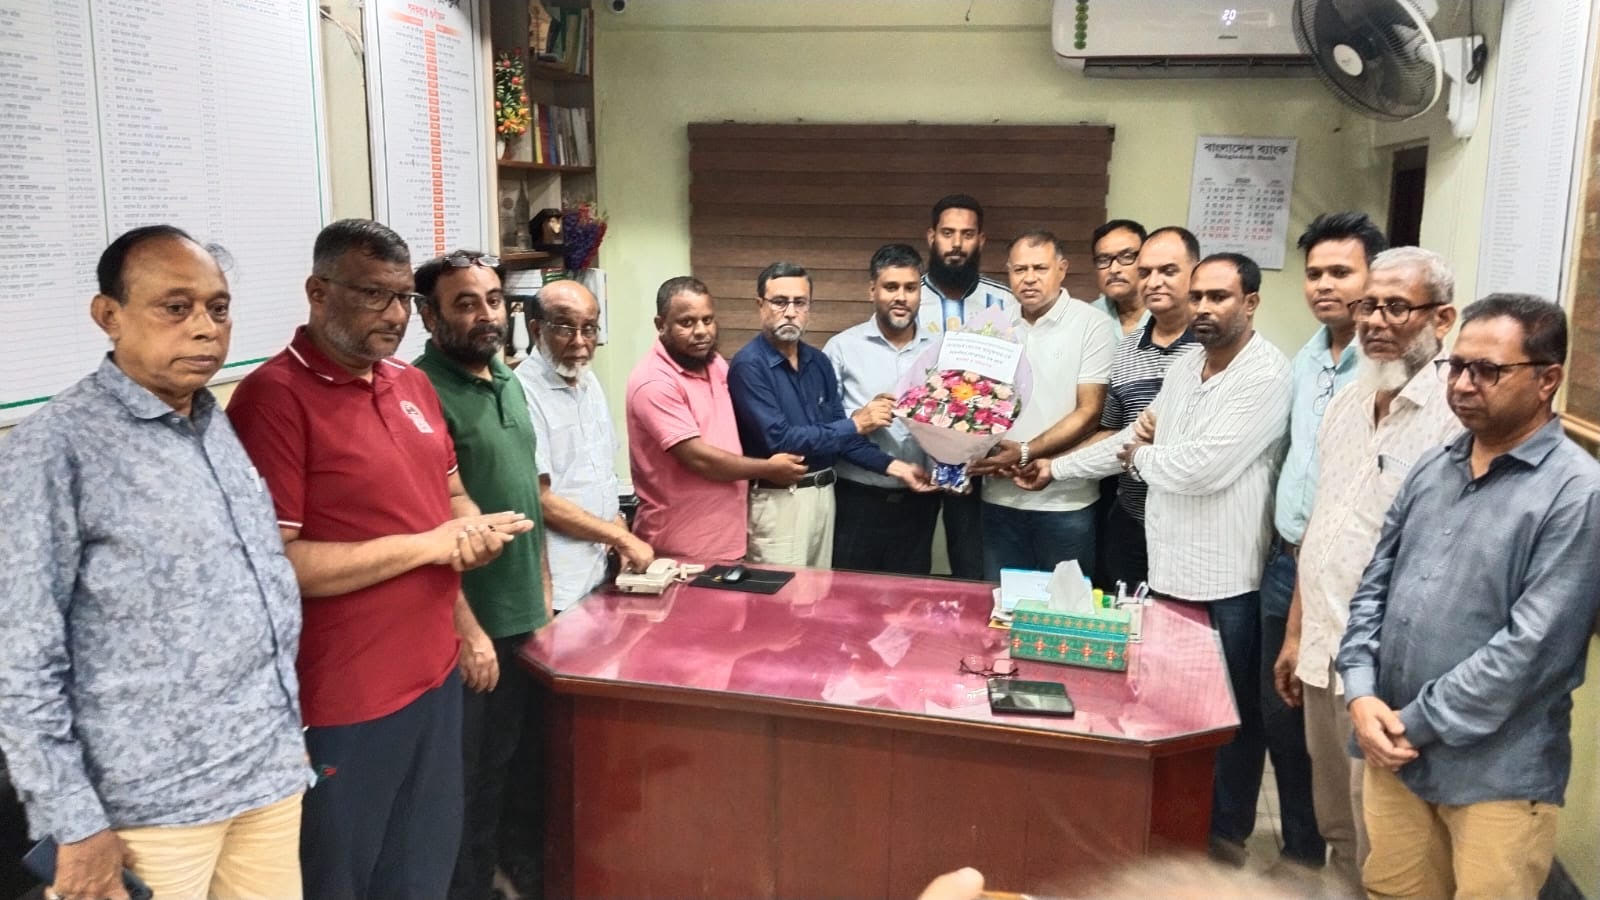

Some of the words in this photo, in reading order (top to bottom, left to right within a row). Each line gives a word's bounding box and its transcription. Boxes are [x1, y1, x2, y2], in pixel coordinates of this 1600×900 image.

[1222, 9, 1237, 20] 20
[1204, 143, 1254, 154] বাংলাদেশ
[1257, 144, 1289, 155] ব্যাংক
